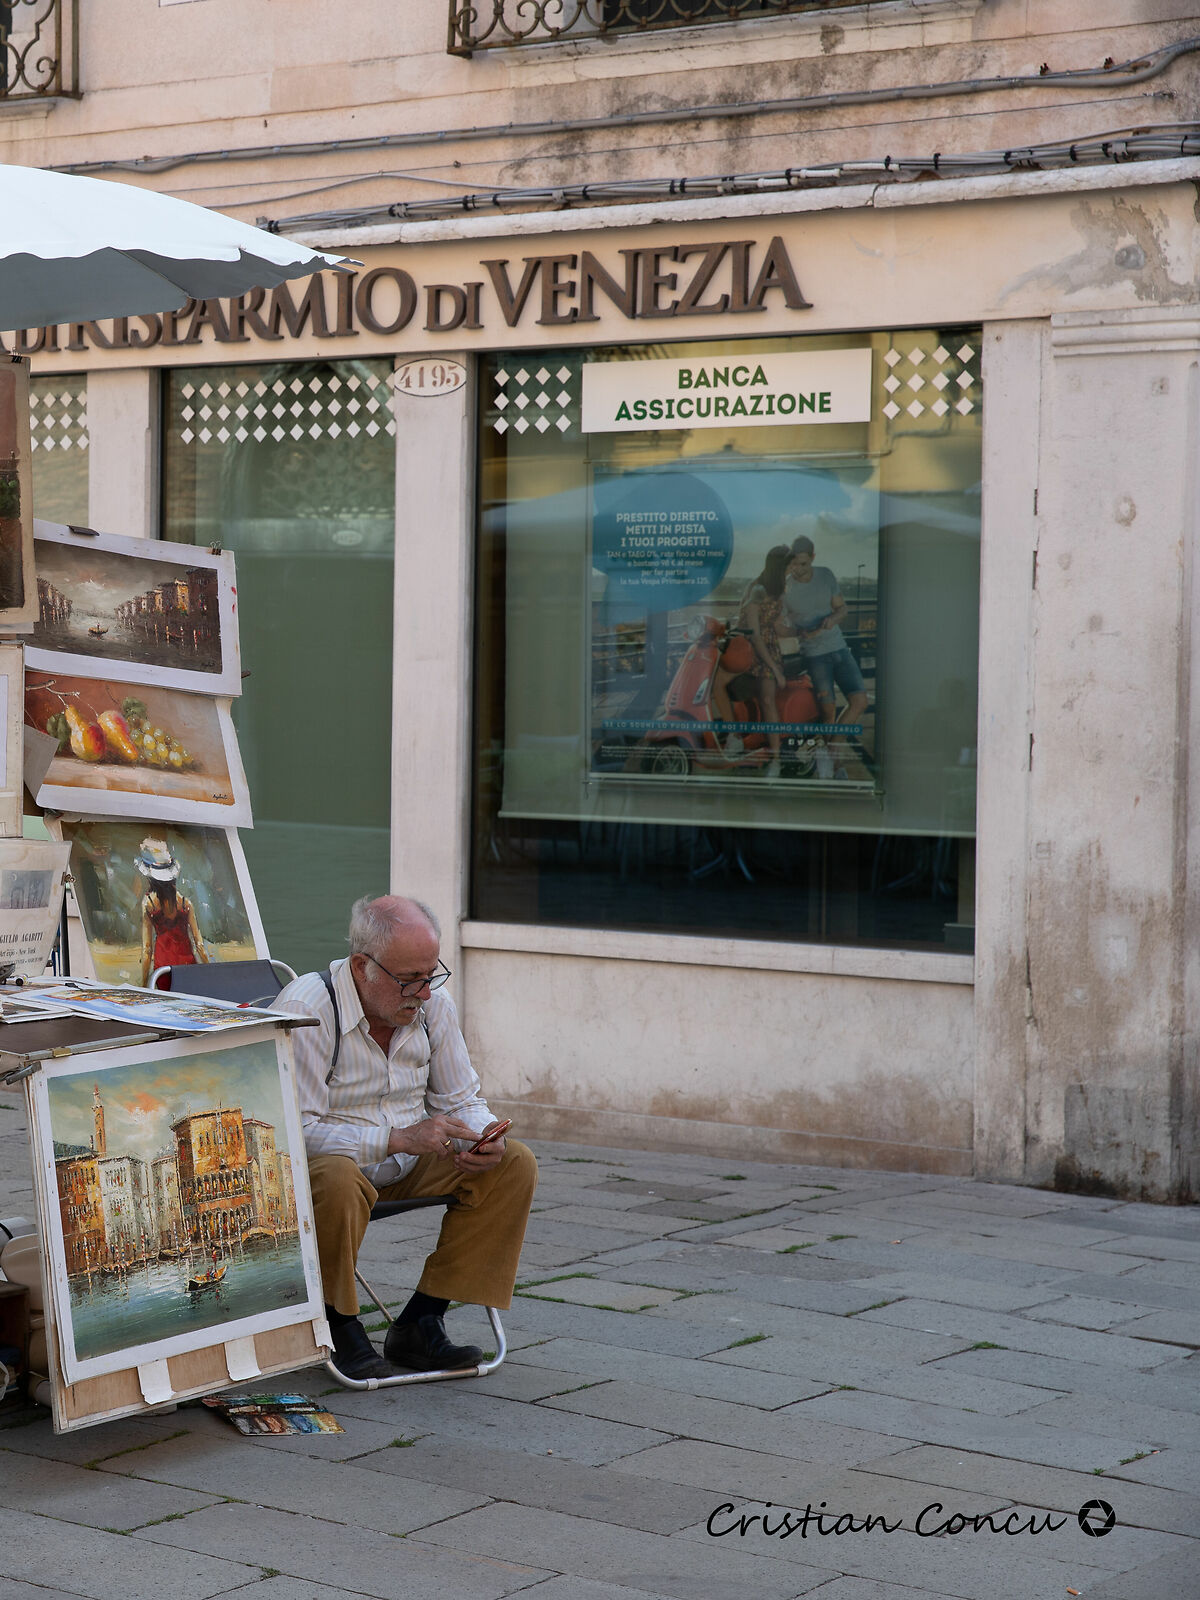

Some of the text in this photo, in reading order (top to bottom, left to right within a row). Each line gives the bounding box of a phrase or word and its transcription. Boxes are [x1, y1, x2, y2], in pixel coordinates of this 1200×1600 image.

[424, 281, 484, 332] DI
[480, 236, 814, 327] VENEZIA
[400, 365, 460, 388] 4195
[678, 364, 768, 389] BANCA
[615, 391, 832, 421] ASSICURAZIONE
[616, 511, 719, 523] PRESTITO DIRETTO.
[626, 524, 706, 535] METTI IN PISTA
[621, 536, 710, 547] I TUOI PROGETTI
